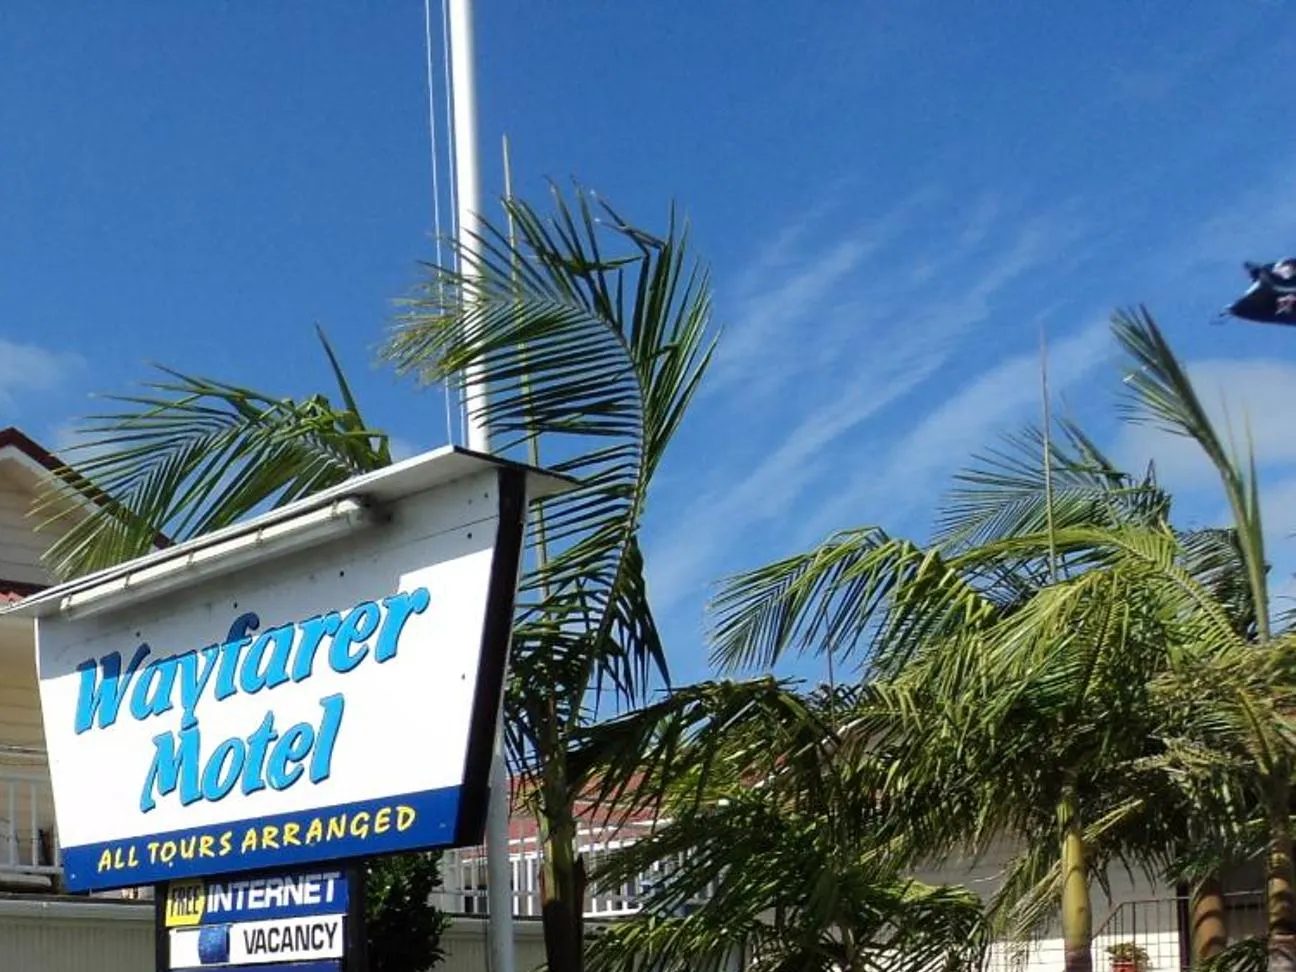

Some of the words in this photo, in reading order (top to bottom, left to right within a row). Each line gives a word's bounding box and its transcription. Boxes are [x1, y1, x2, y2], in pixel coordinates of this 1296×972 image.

[75, 587, 430, 735] Wayfarer
[140, 694, 344, 812] Motel
[98, 847, 138, 873] ALL
[149, 832, 231, 861] TOURS
[241, 805, 417, 851] ARRANGED
[170, 884, 202, 916] FREE
[207, 872, 341, 913] INTERNET
[243, 922, 337, 955] VACANCY
